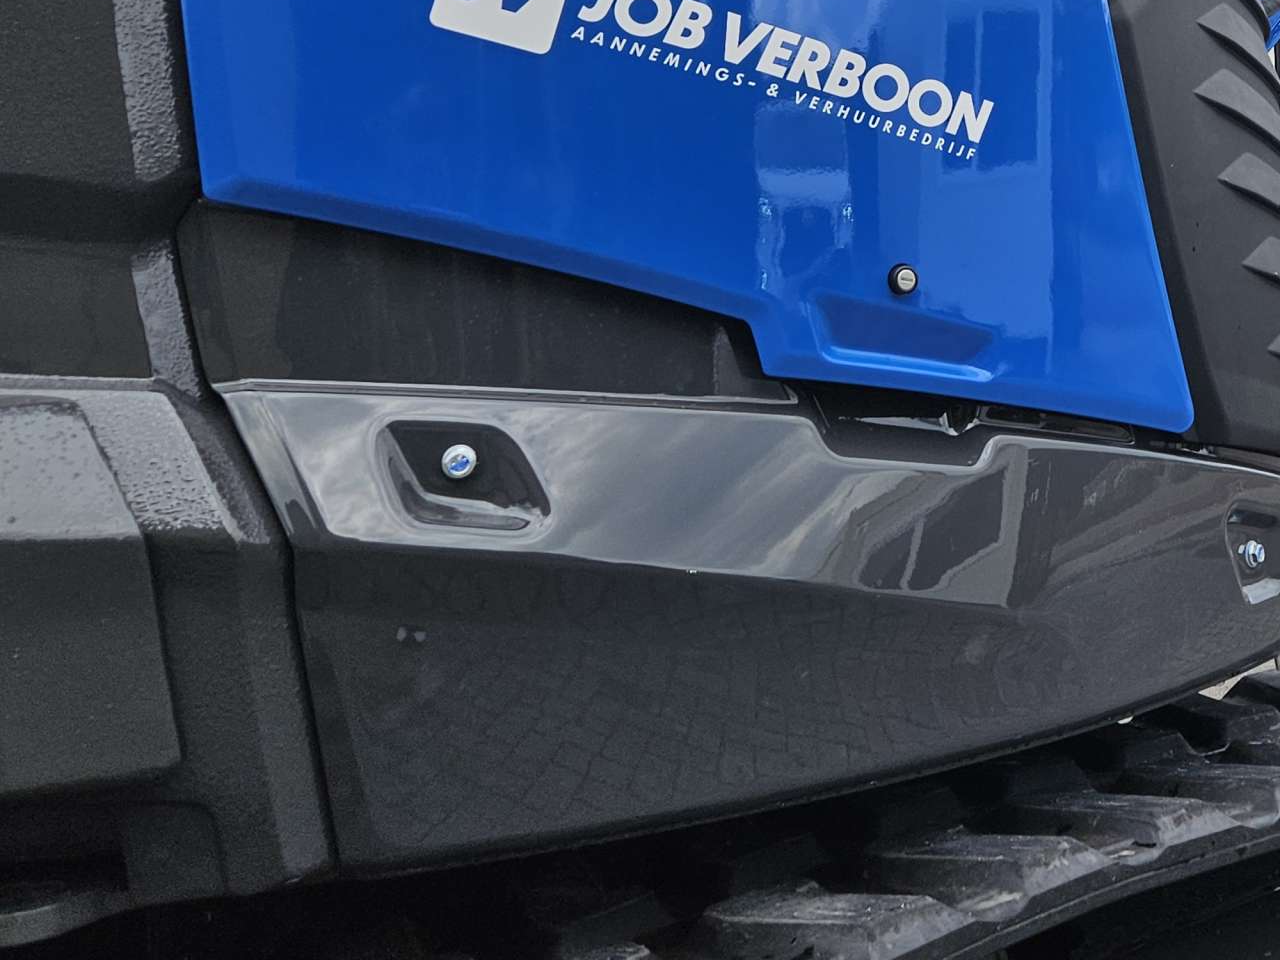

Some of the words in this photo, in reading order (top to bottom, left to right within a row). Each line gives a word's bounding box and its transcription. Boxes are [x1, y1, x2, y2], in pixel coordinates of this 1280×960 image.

[571, 26, 757, 87] AANNEMINGS-
[766, 82, 778, 98] &
[795, 91, 977, 161] VERHUURBEDRIJF
[724, 11, 994, 143] VERBOON
